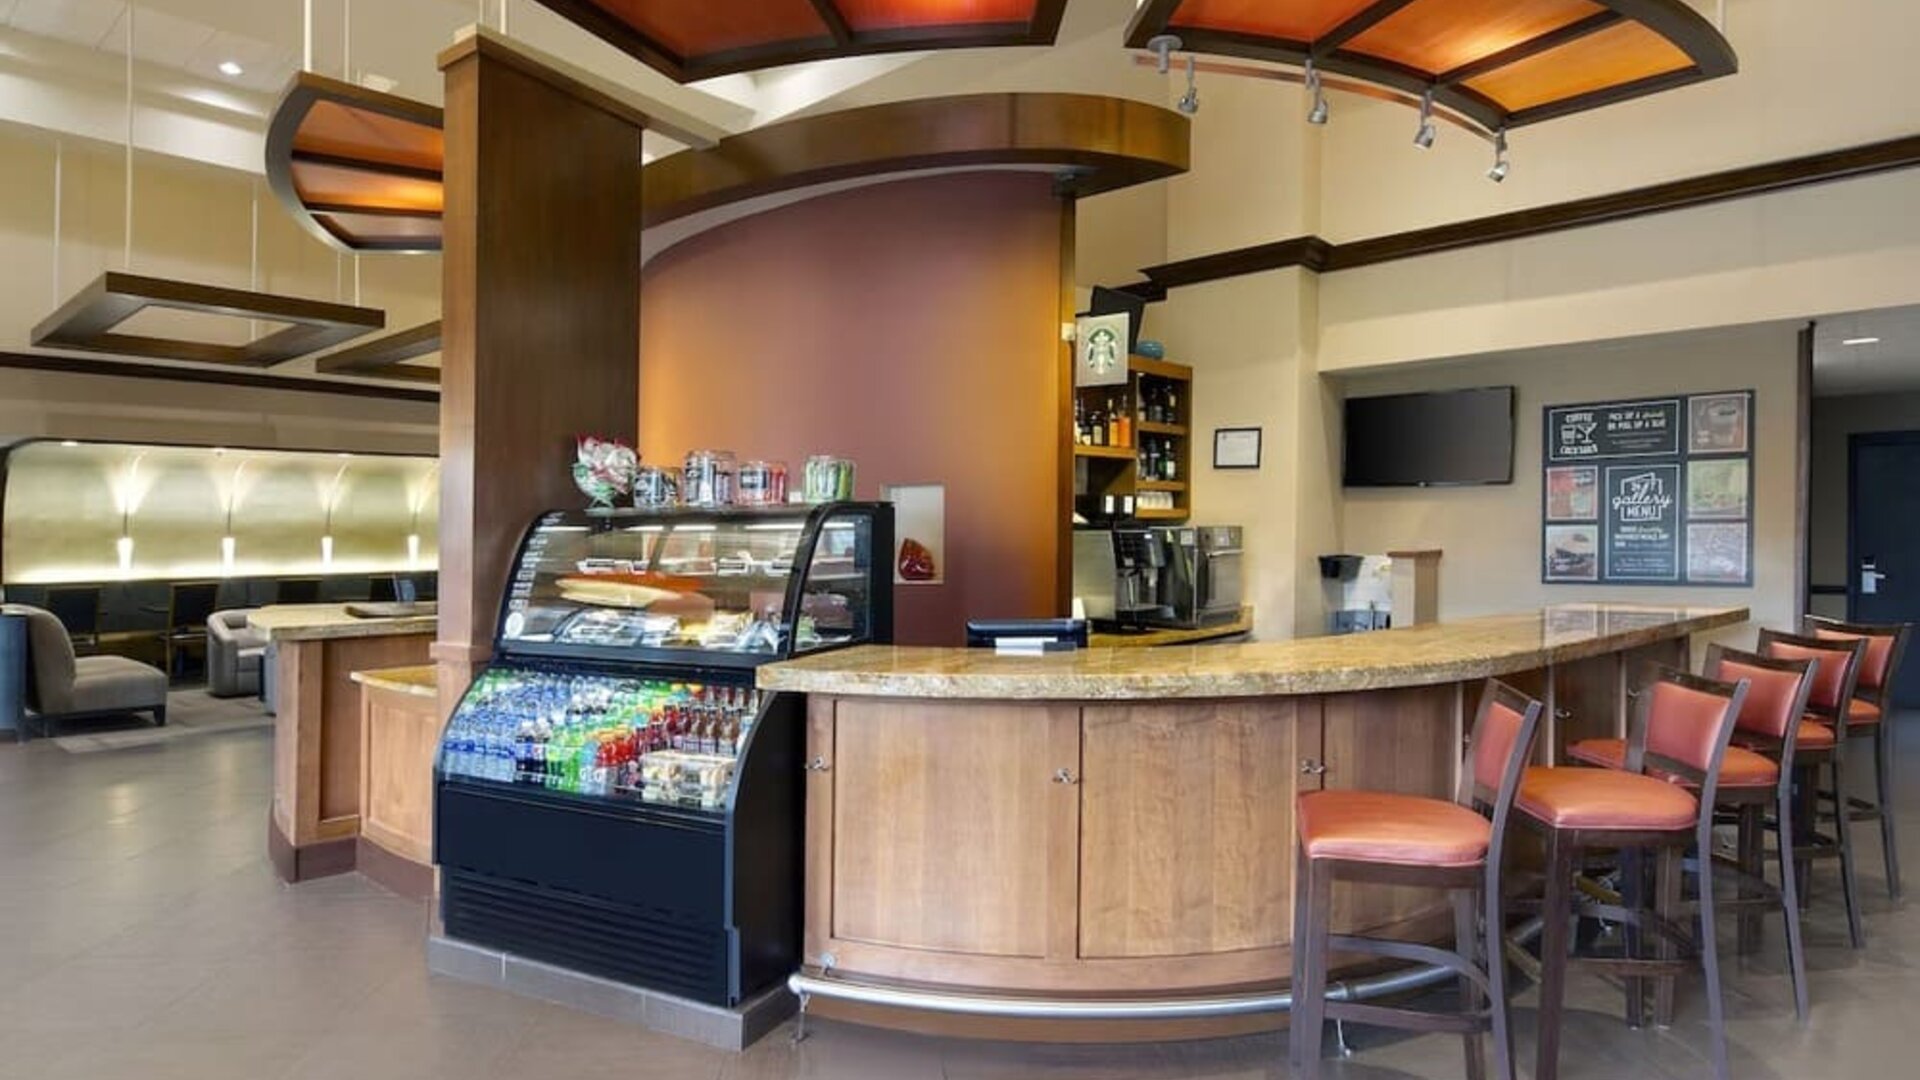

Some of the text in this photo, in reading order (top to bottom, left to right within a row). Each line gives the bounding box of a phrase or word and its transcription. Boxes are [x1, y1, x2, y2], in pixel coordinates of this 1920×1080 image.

[1566, 413, 1594, 423] COFFEE
[1612, 485, 1672, 510] gallery
[1626, 506, 1656, 517] MENU
